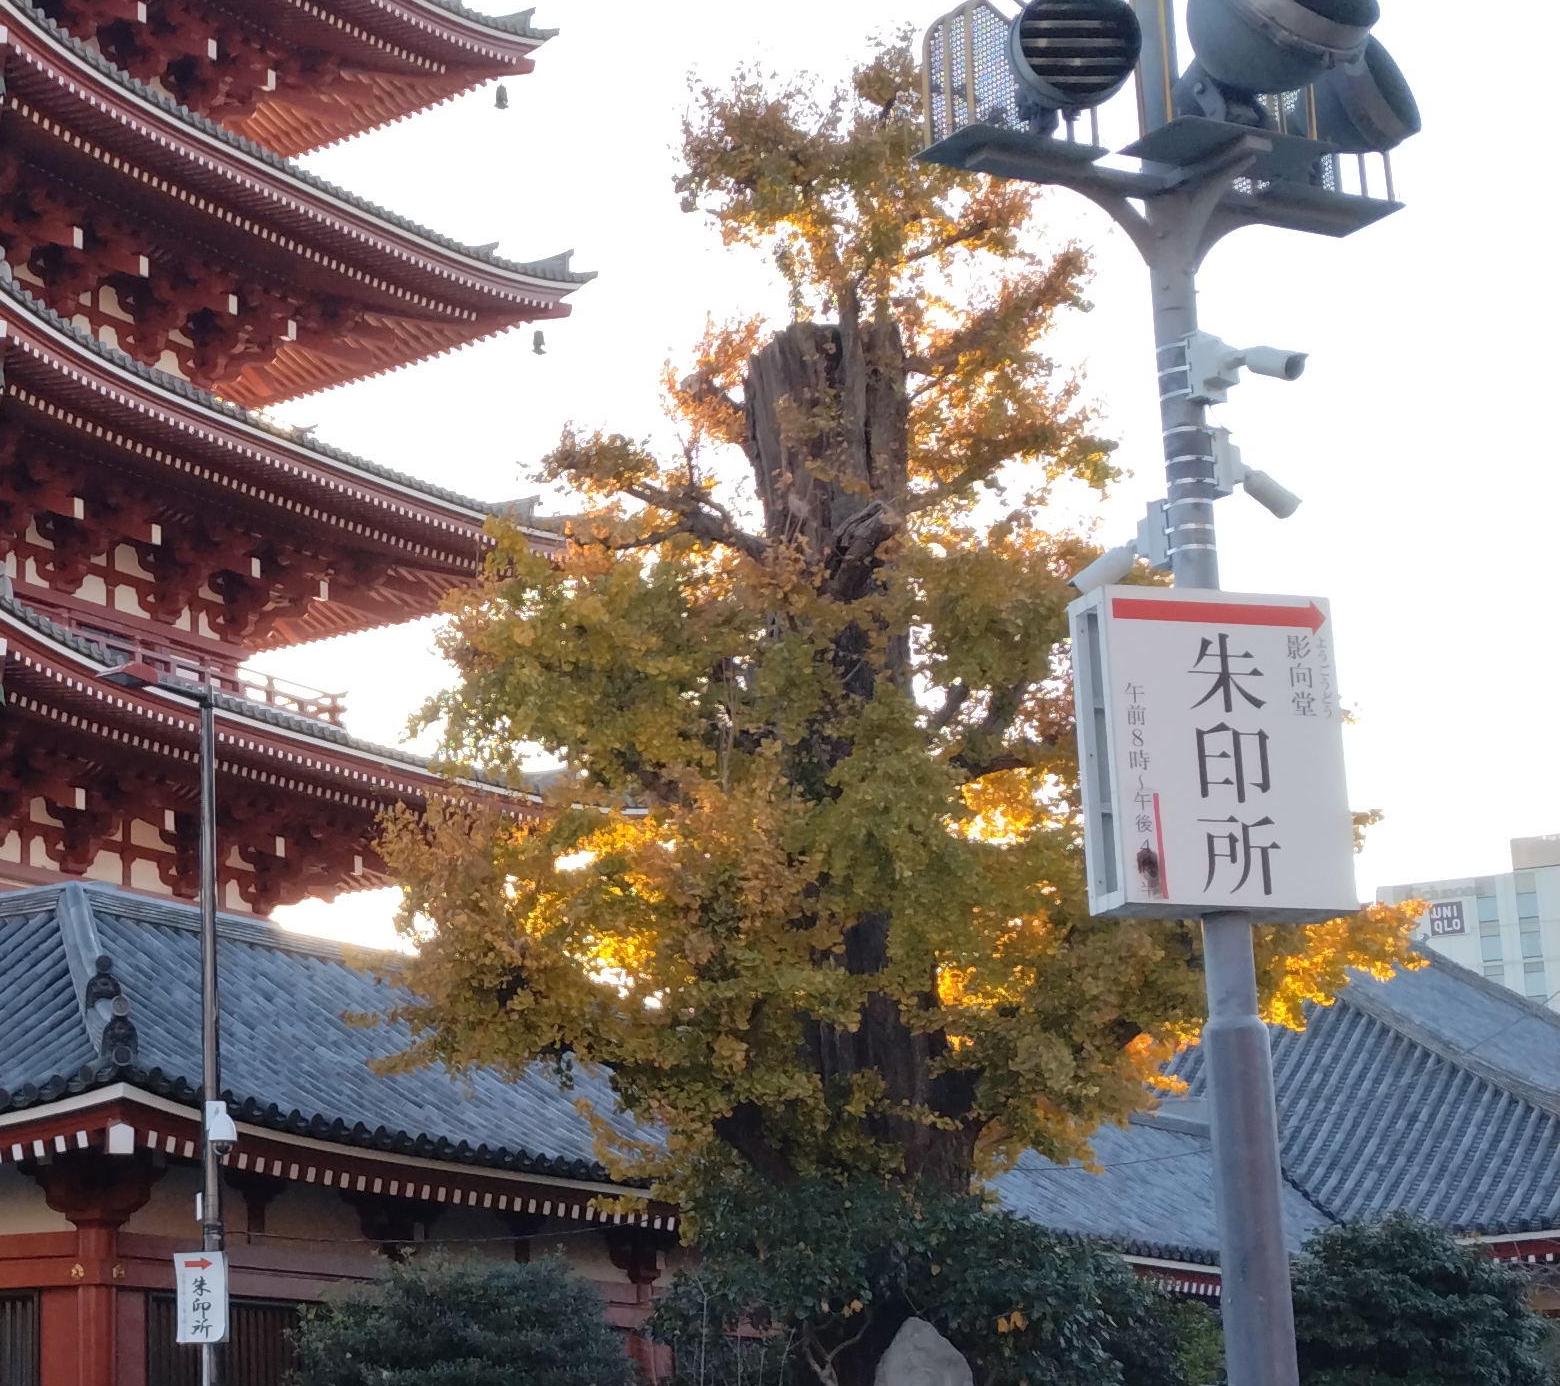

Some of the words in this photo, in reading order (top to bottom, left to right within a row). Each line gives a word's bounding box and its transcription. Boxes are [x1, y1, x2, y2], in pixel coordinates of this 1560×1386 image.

[1286, 634, 1318, 717] 影向堂
[1124, 682, 1158, 899] 午前8時〜午後4半
[1187, 632, 1282, 896] 朱印所
[1432, 904, 1458, 919] UNI
[1433, 918, 1461, 933] QLO
[191, 1275, 213, 1340] 朱印所
